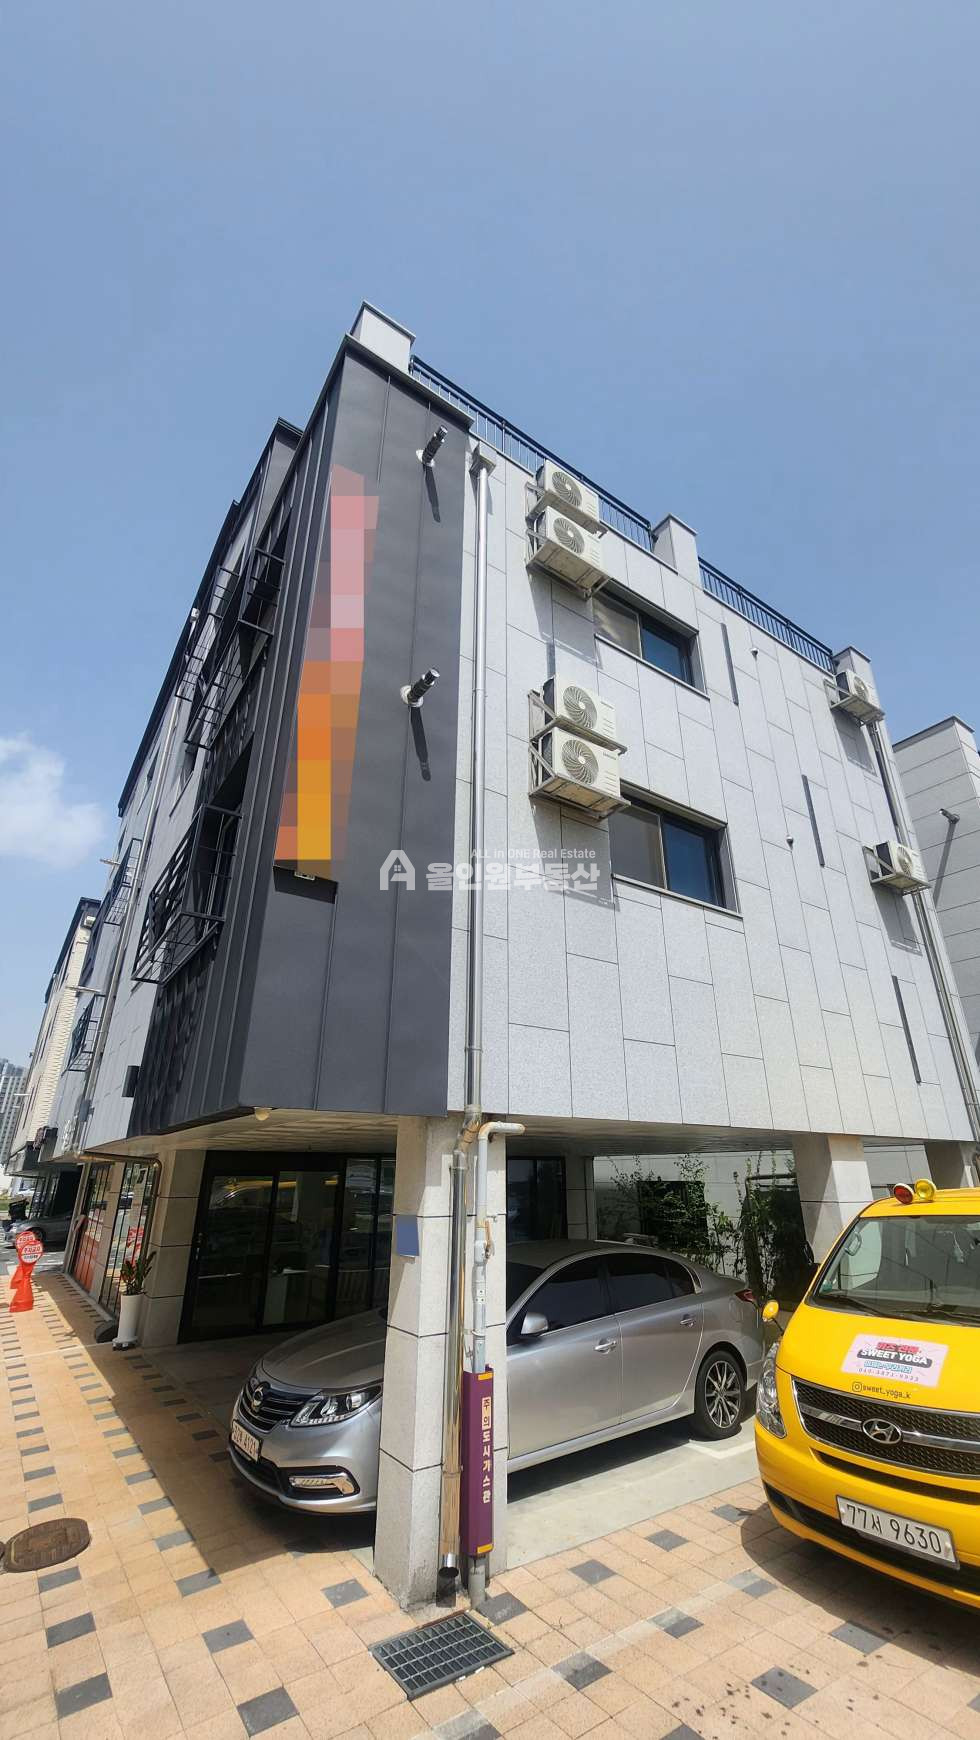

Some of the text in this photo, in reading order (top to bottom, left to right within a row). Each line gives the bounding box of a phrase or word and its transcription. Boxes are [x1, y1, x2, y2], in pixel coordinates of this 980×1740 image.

[861, 1347, 898, 1360] SWEET
[898, 1352, 928, 1365] YOGA
[846, 1503, 942, 1554] 77서 9630
